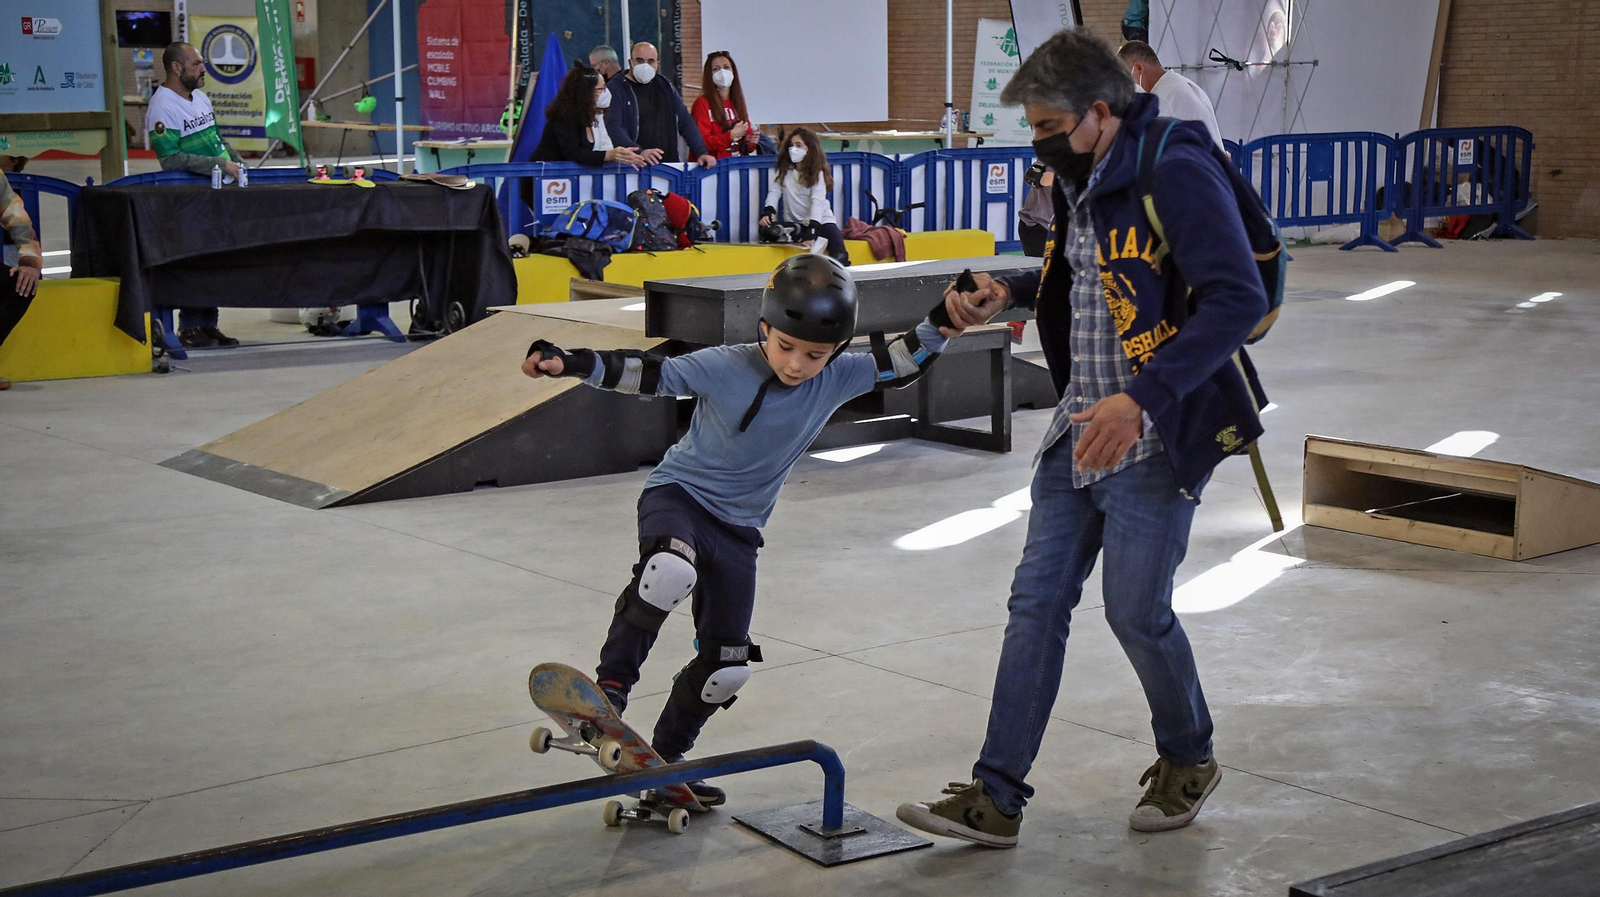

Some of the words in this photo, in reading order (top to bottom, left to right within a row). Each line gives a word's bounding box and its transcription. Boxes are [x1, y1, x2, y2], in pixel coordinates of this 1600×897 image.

[519, 29, 530, 87] Escalada
[427, 63, 450, 73] MOBILE
[426, 76, 457, 87] CLIMBING
[206, 91, 253, 100] Federación
[427, 89, 446, 100] WALL
[480, 123, 504, 134] ARCO
[546, 196, 568, 205] esm
